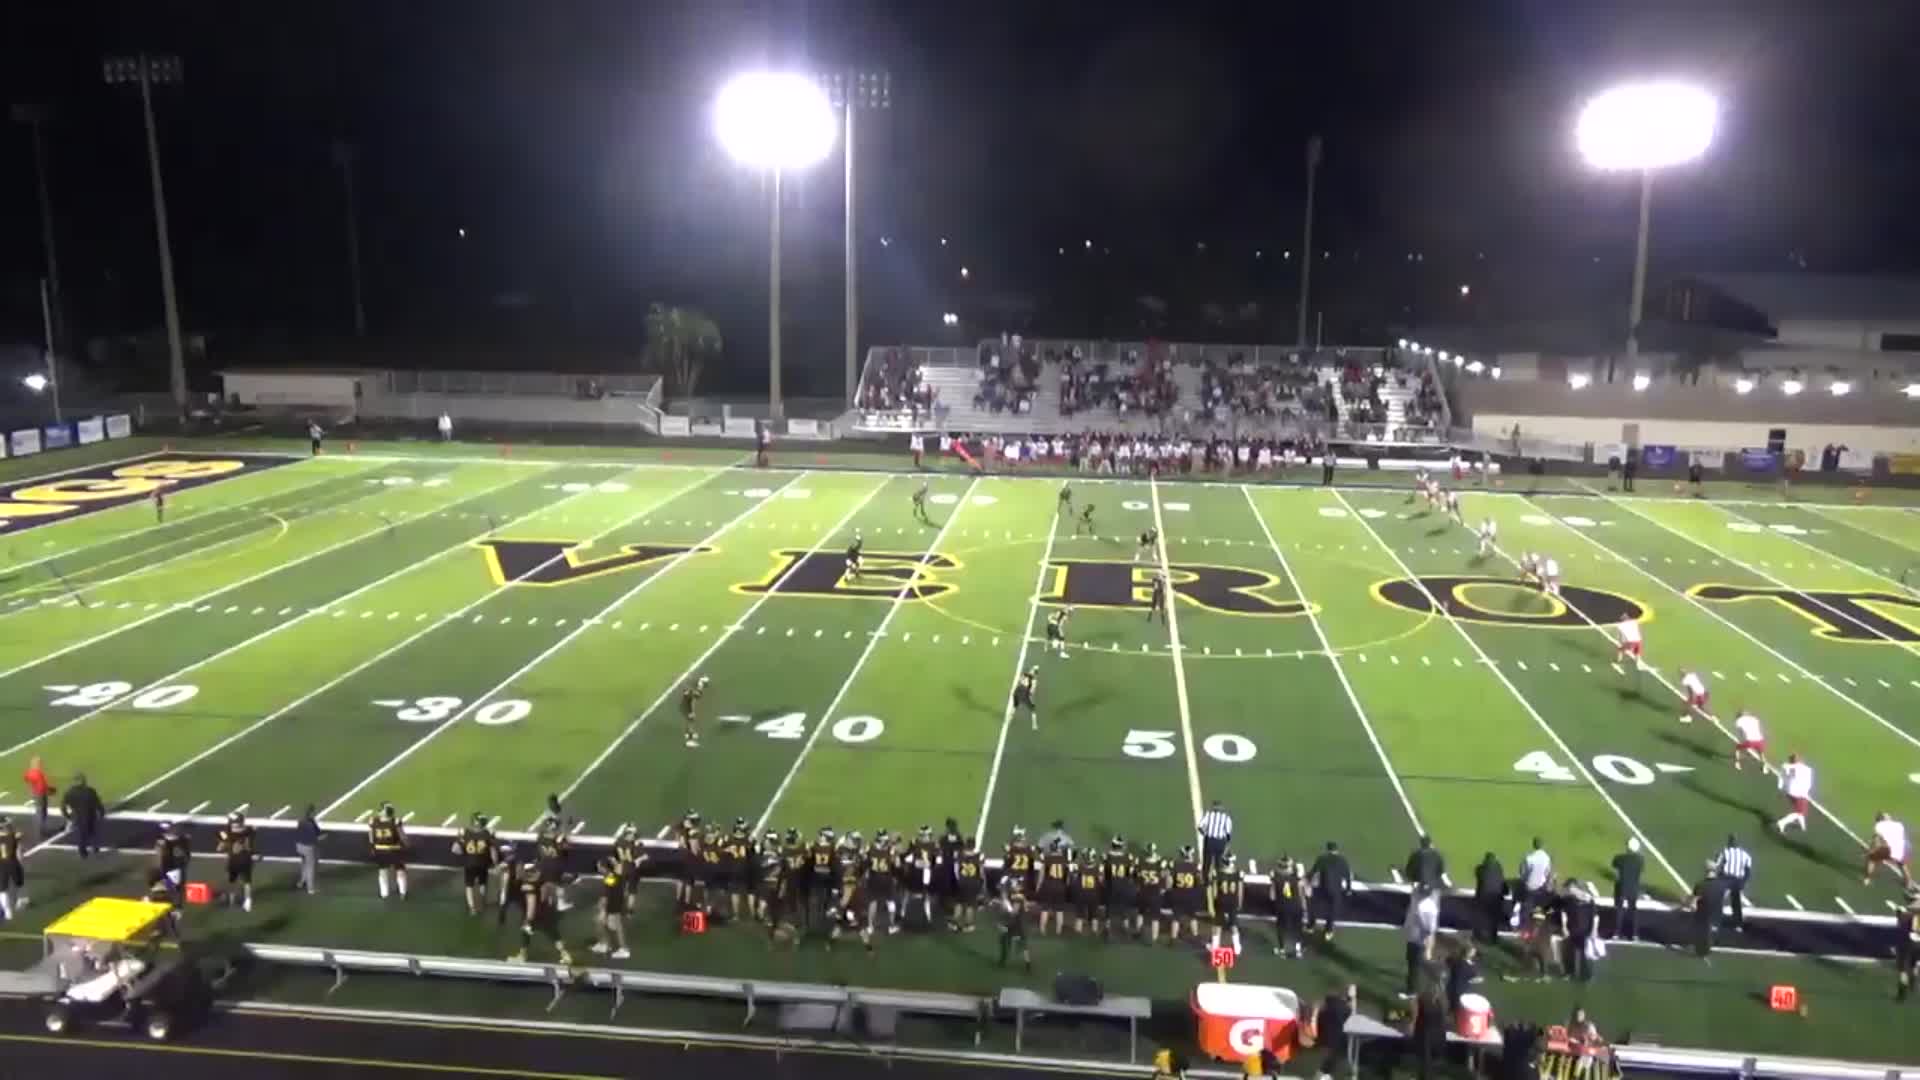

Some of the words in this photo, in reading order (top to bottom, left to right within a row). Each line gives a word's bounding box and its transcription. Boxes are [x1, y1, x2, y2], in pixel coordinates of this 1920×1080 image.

[394, 696, 533, 726] 30
[755, 712, 885, 744] 40
[1121, 729, 1258, 763] 50
[1512, 750, 1656, 785] 40
[1213, 949, 1231, 966] 50
